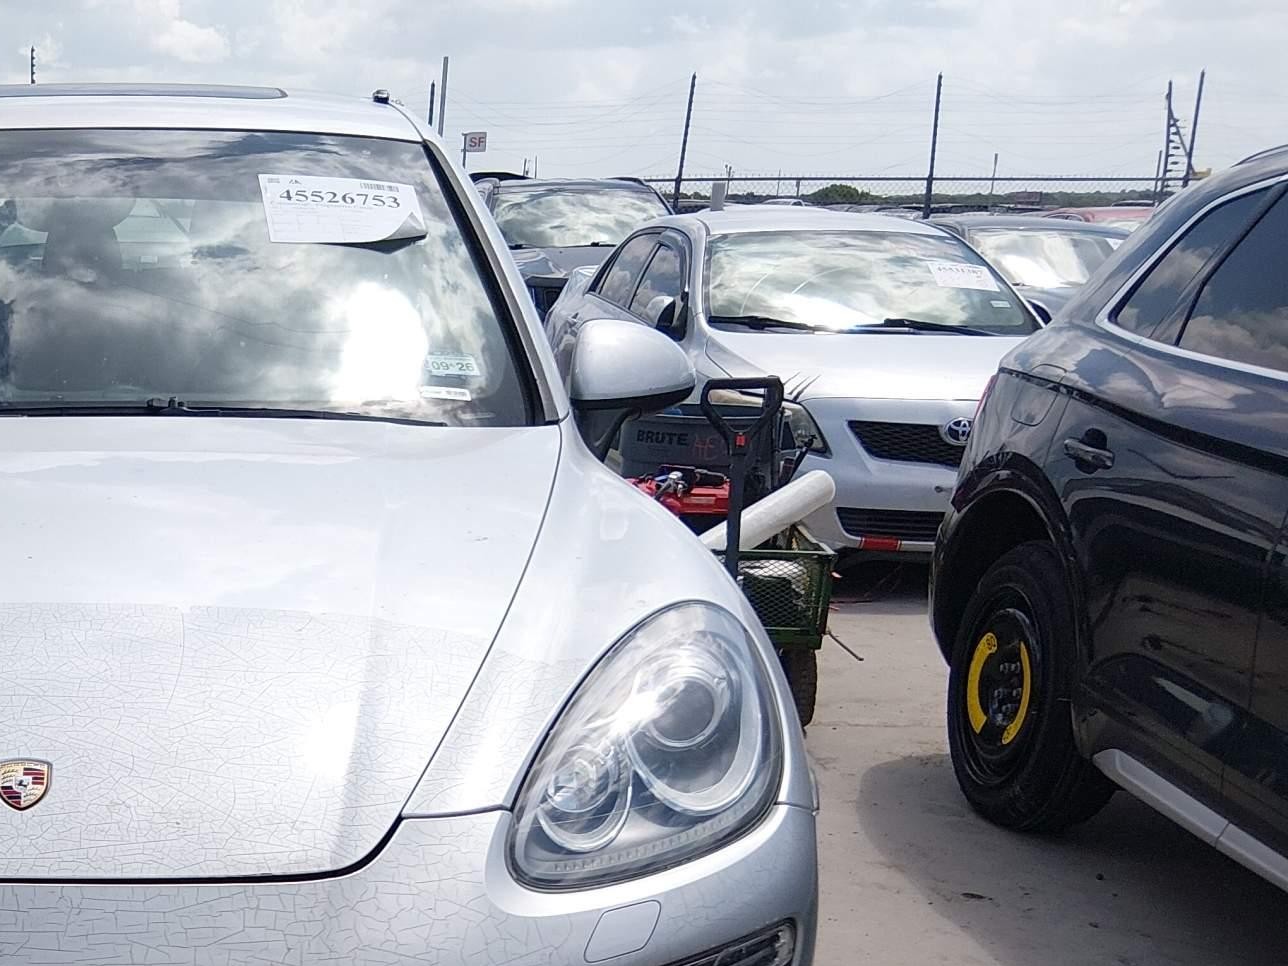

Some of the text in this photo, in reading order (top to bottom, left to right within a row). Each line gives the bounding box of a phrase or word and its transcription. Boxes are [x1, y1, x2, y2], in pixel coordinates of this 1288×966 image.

[469, 136, 485, 148] SF
[279, 189, 401, 209] 45526753
[636, 429, 689, 446] BRUTE
